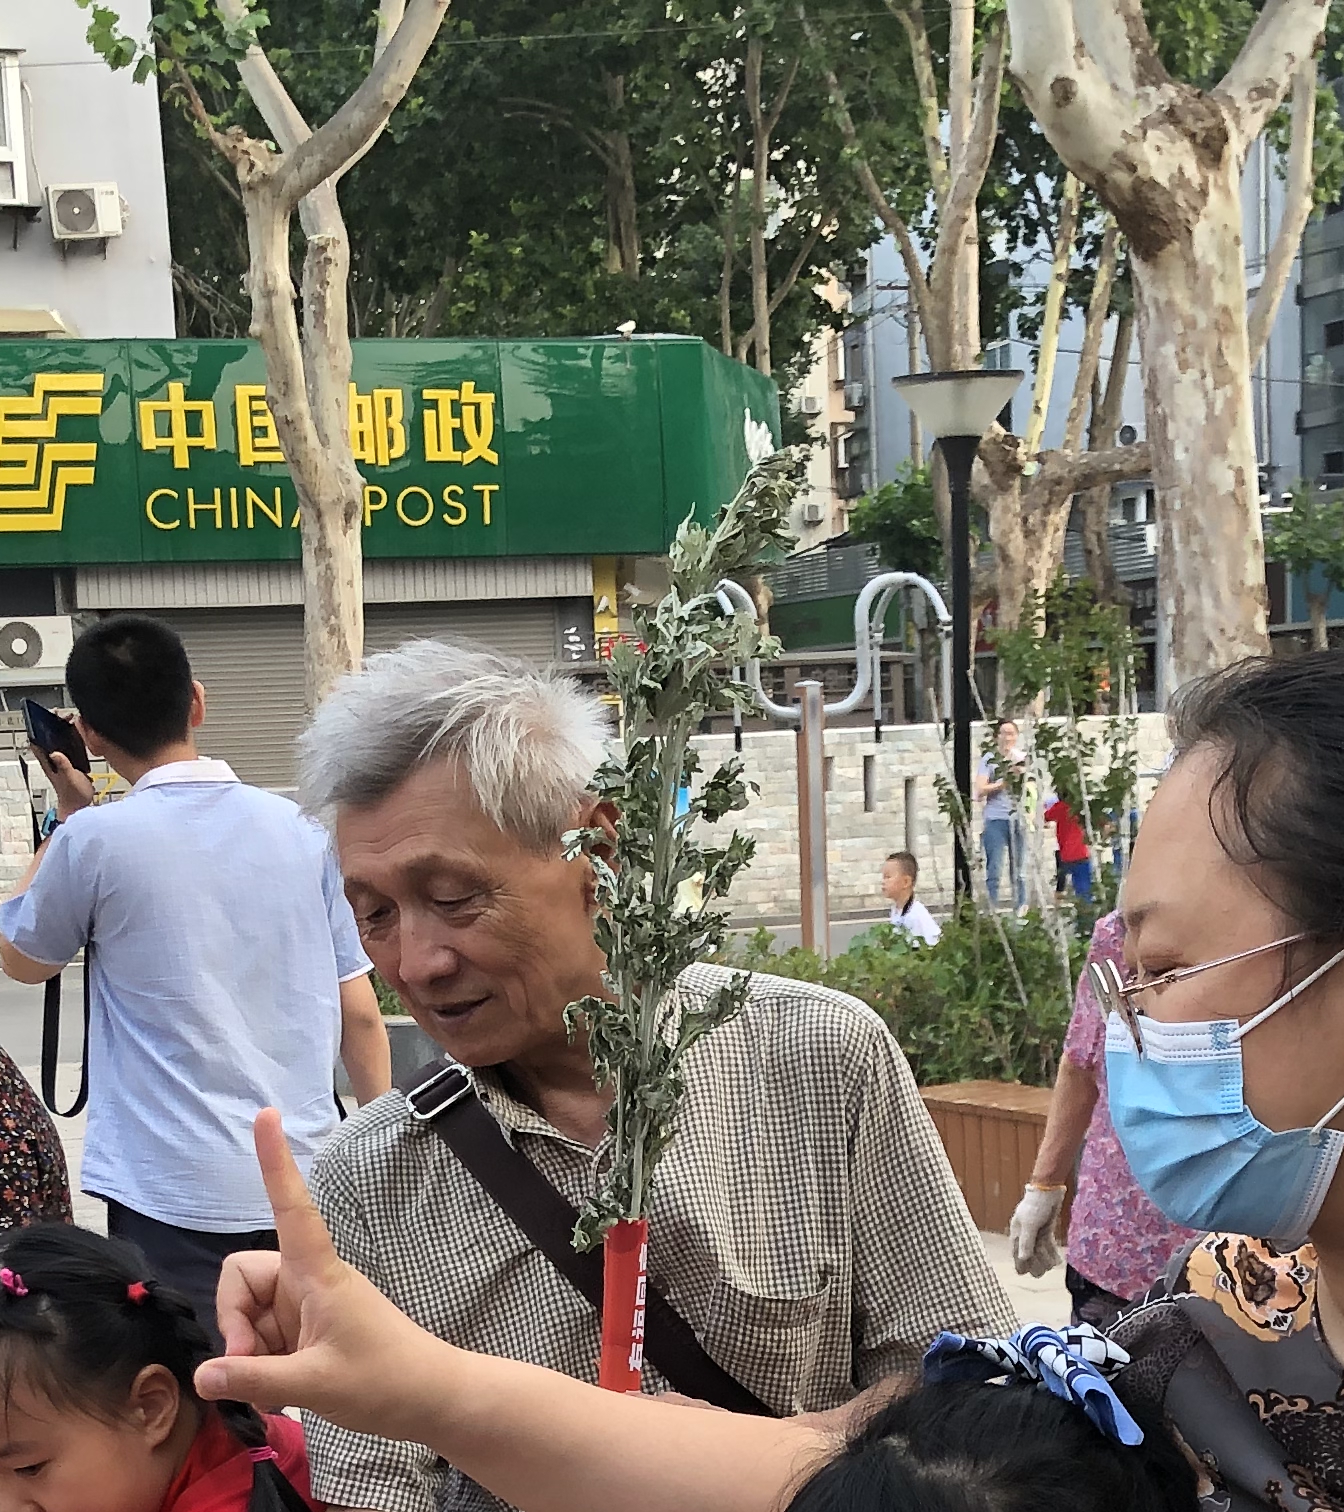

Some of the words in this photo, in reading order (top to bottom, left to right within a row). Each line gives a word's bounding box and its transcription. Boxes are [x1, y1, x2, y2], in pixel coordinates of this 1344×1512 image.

[139, 381, 499, 468] 中国邮政
[145, 486, 301, 529] CHIN
[363, 484, 500, 527] POST
